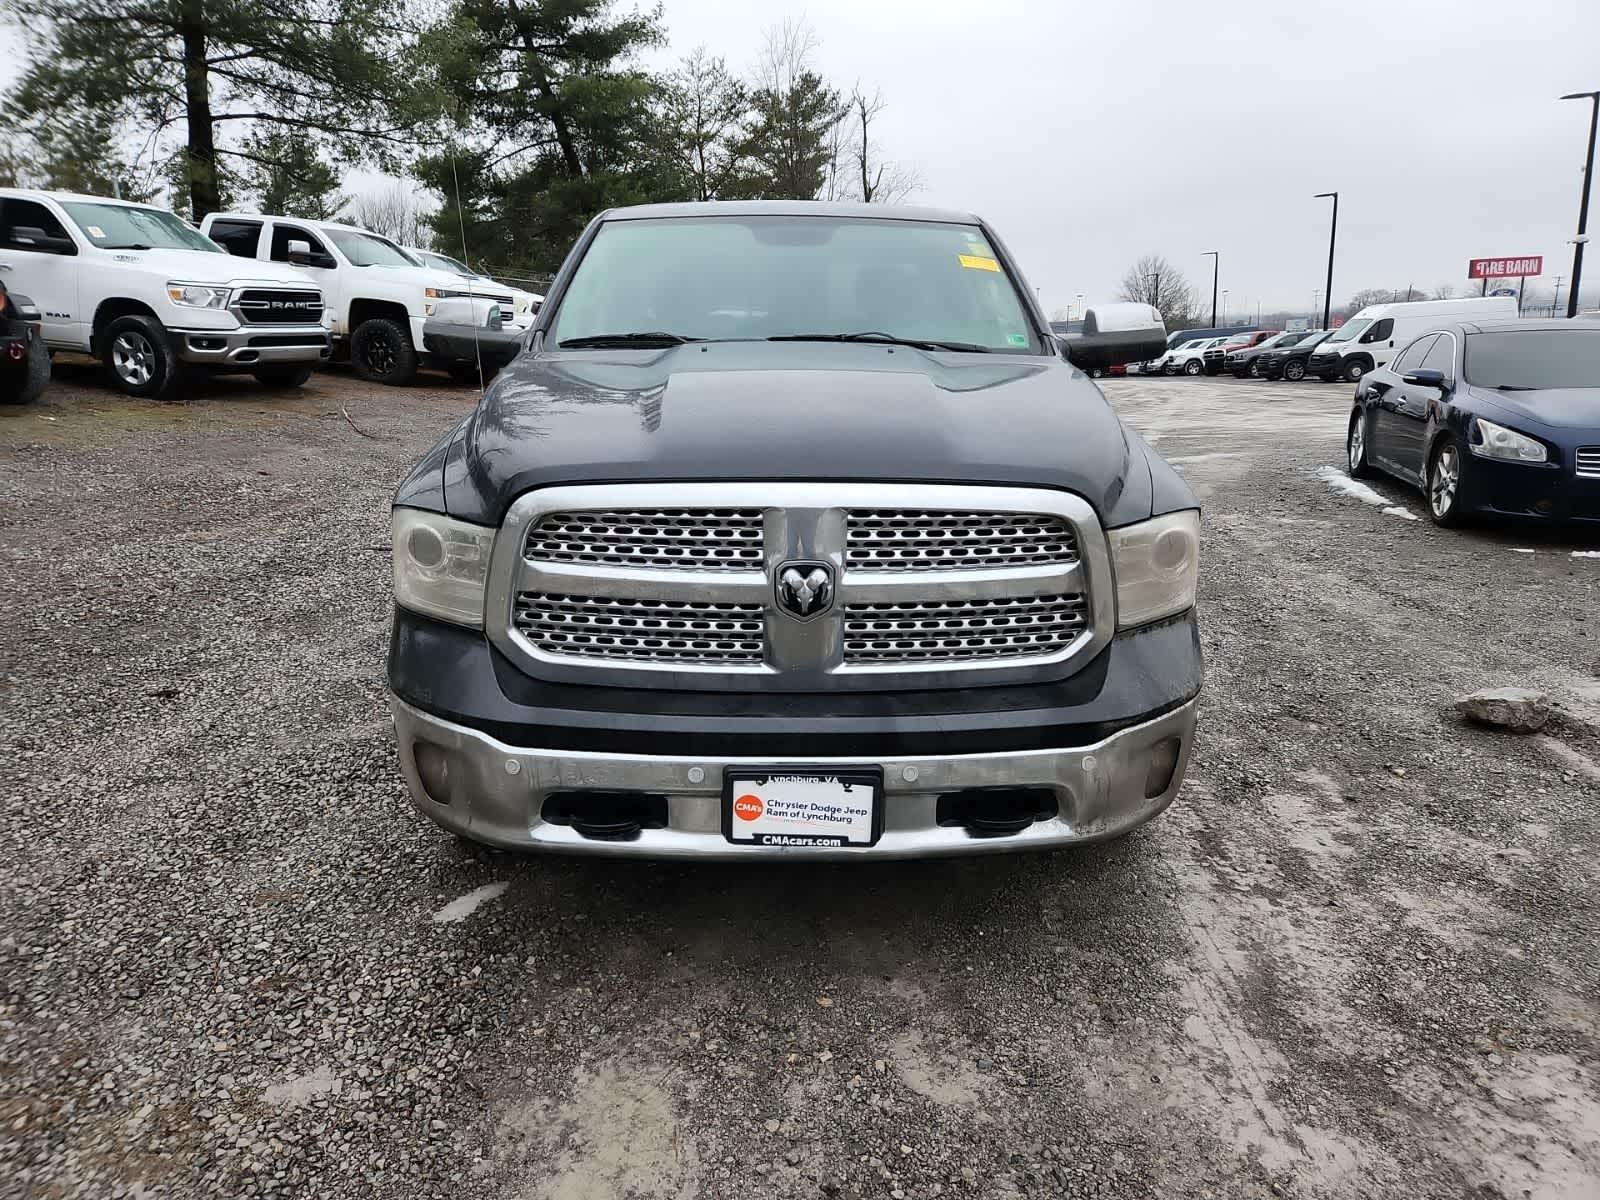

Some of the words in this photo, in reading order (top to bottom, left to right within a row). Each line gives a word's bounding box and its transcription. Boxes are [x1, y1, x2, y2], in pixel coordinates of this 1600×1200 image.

[1476, 261, 1505, 275] TIRE
[1506, 259, 1538, 273] BARN
[271, 301, 306, 309] RAM
[824, 776, 839, 784] VA
[767, 799, 808, 810] Chrysler
[810, 803, 842, 814] Dodge
[843, 807, 868, 816] Jeep
[766, 807, 788, 817] Ram
[789, 810, 800, 818] of
[801, 811, 853, 824] Lynchburg
[762, 835, 841, 847] CMAcars.com
